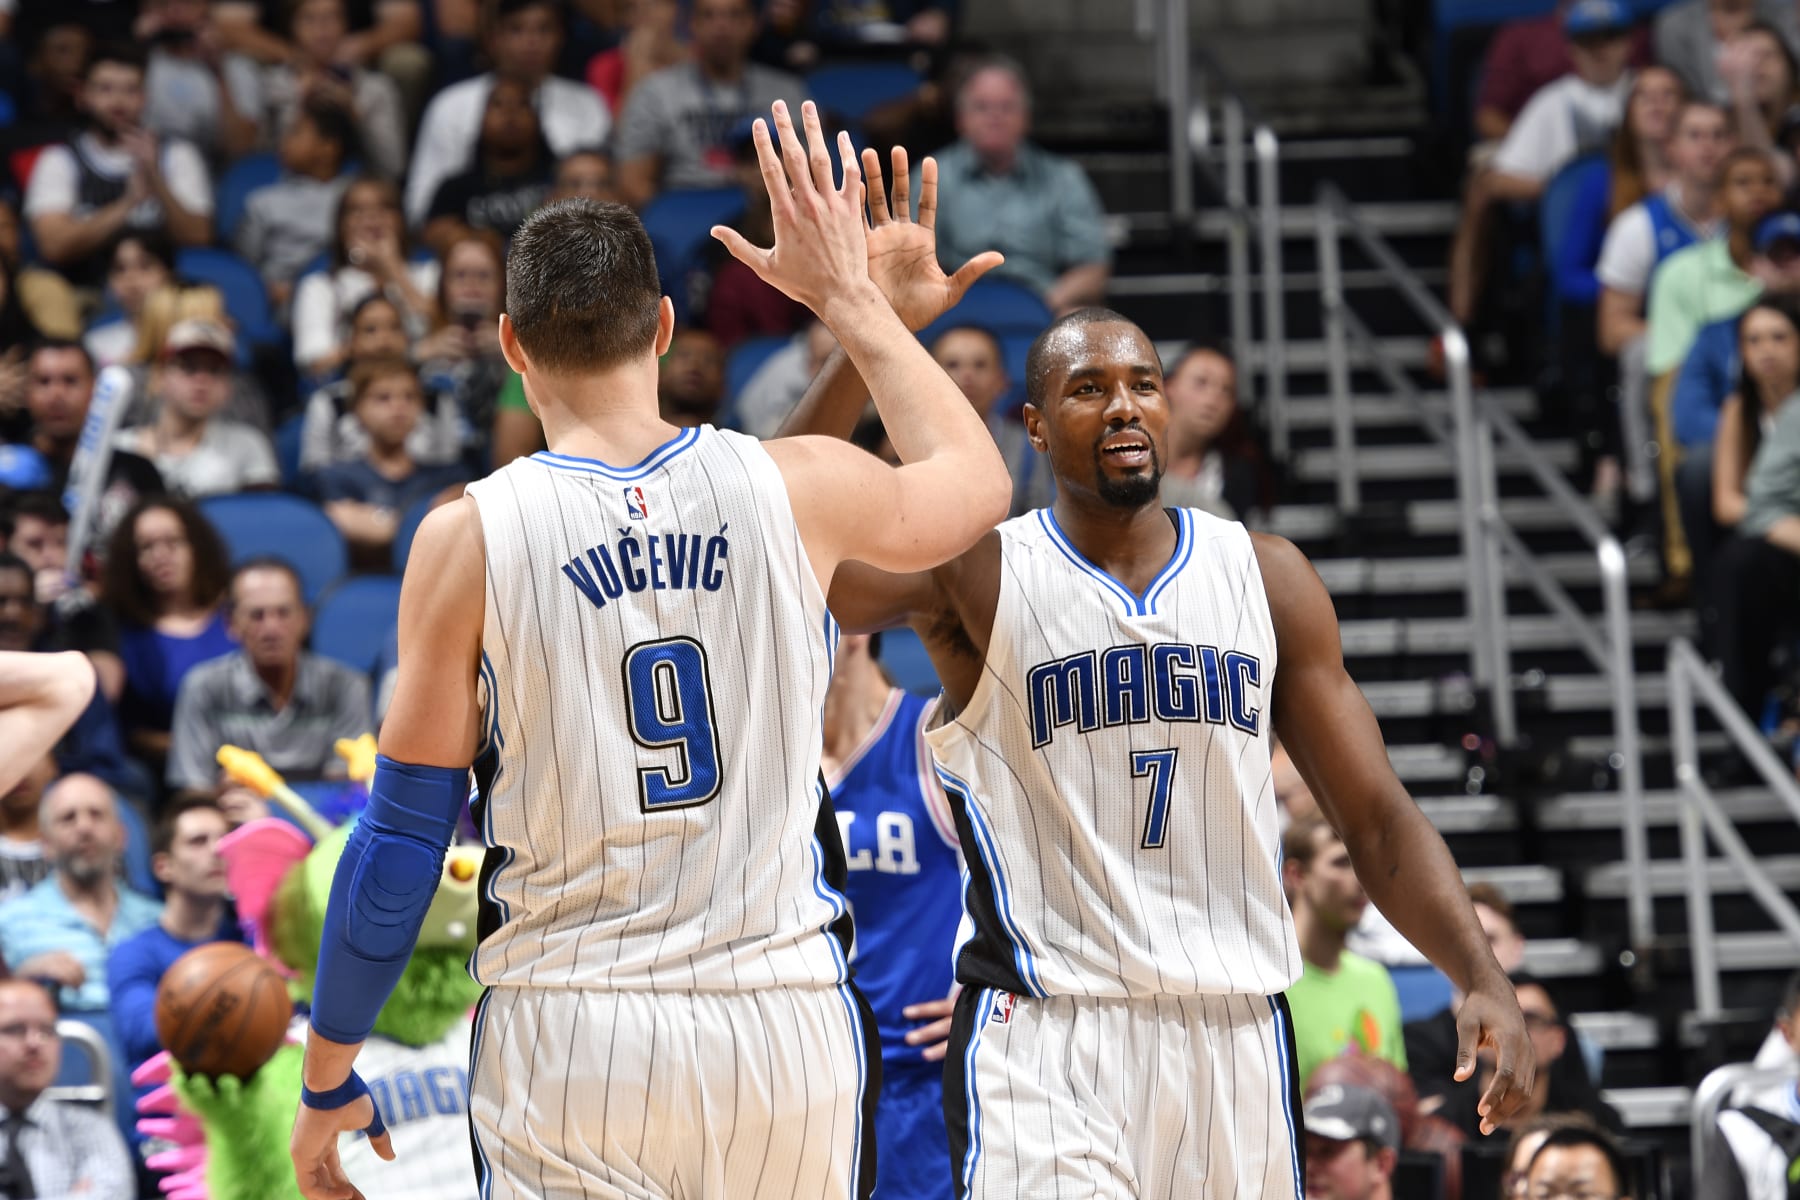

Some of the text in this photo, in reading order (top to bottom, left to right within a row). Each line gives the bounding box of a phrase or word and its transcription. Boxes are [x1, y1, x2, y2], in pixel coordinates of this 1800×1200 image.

[561, 522, 729, 610] VUČEVIĆ
[621, 635, 723, 814] 9
[1026, 642, 1261, 750] MAGIC
[834, 810, 921, 875] LA
[1129, 747, 1179, 849] 7
